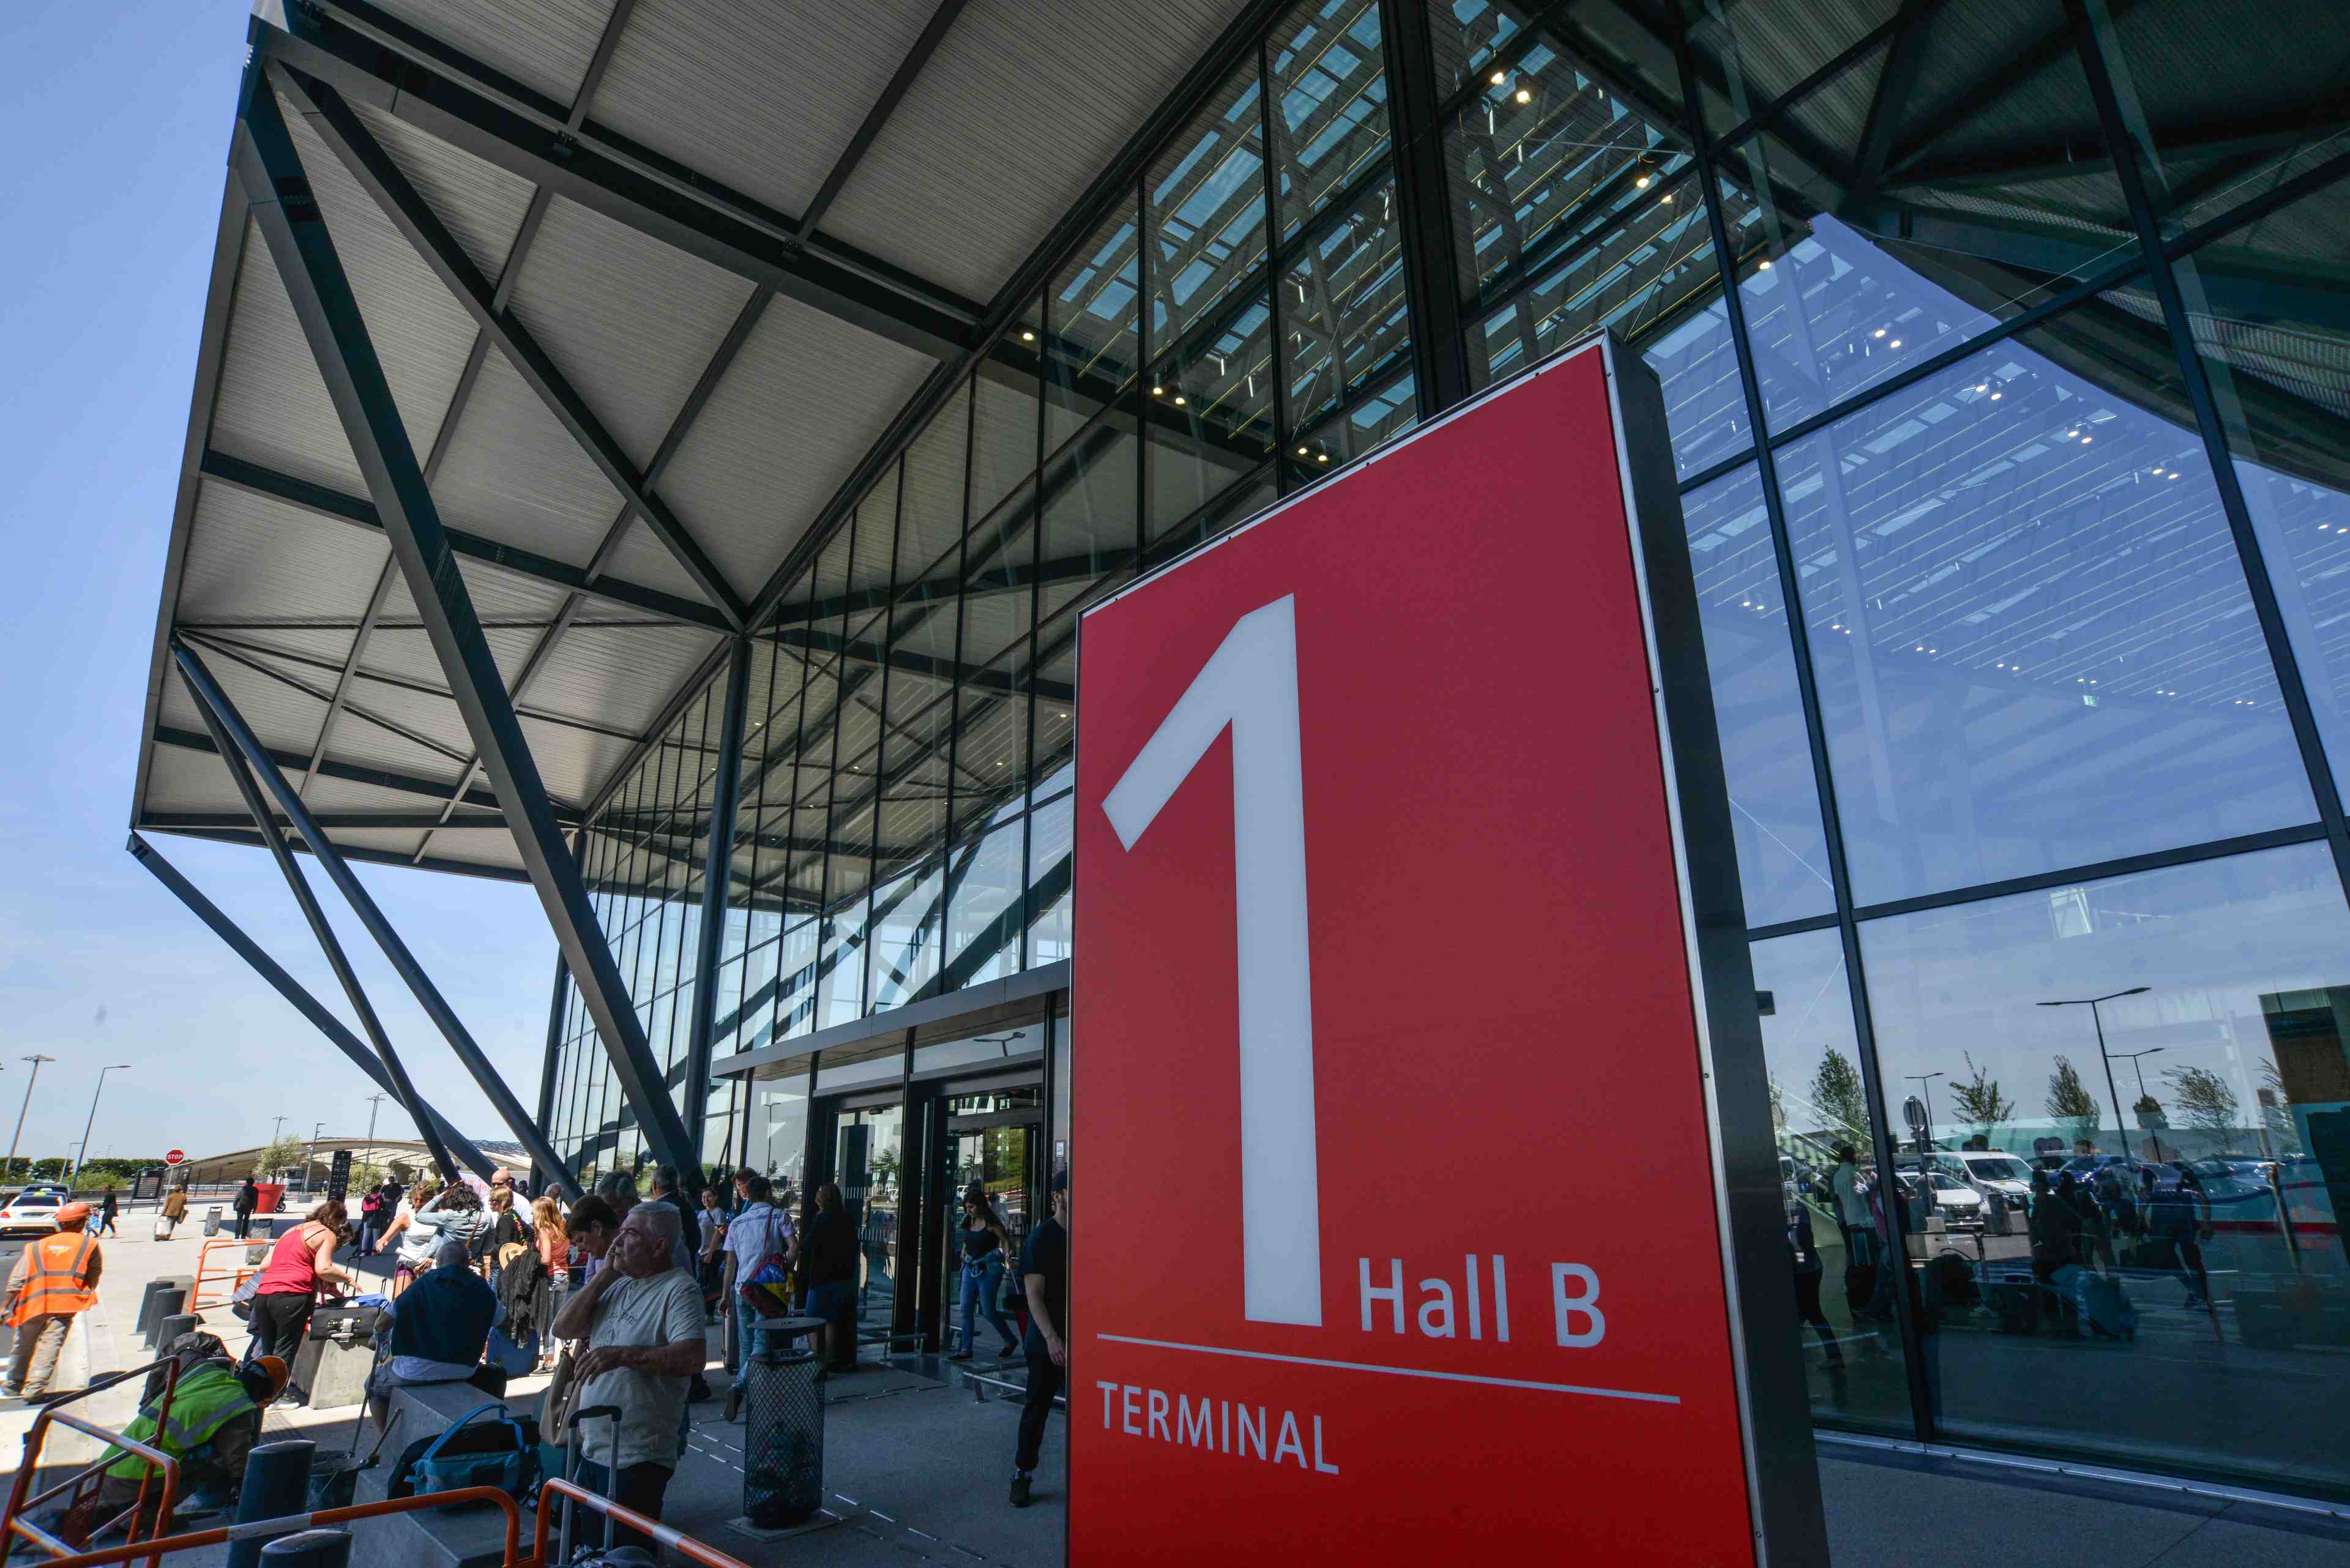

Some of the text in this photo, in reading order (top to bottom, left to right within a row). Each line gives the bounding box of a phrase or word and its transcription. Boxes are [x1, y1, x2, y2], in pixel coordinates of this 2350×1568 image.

[1101, 592, 1323, 1327] 1
[1359, 1253, 1606, 1348] Hall B
[1096, 1380, 1340, 1476] TERMINAL
